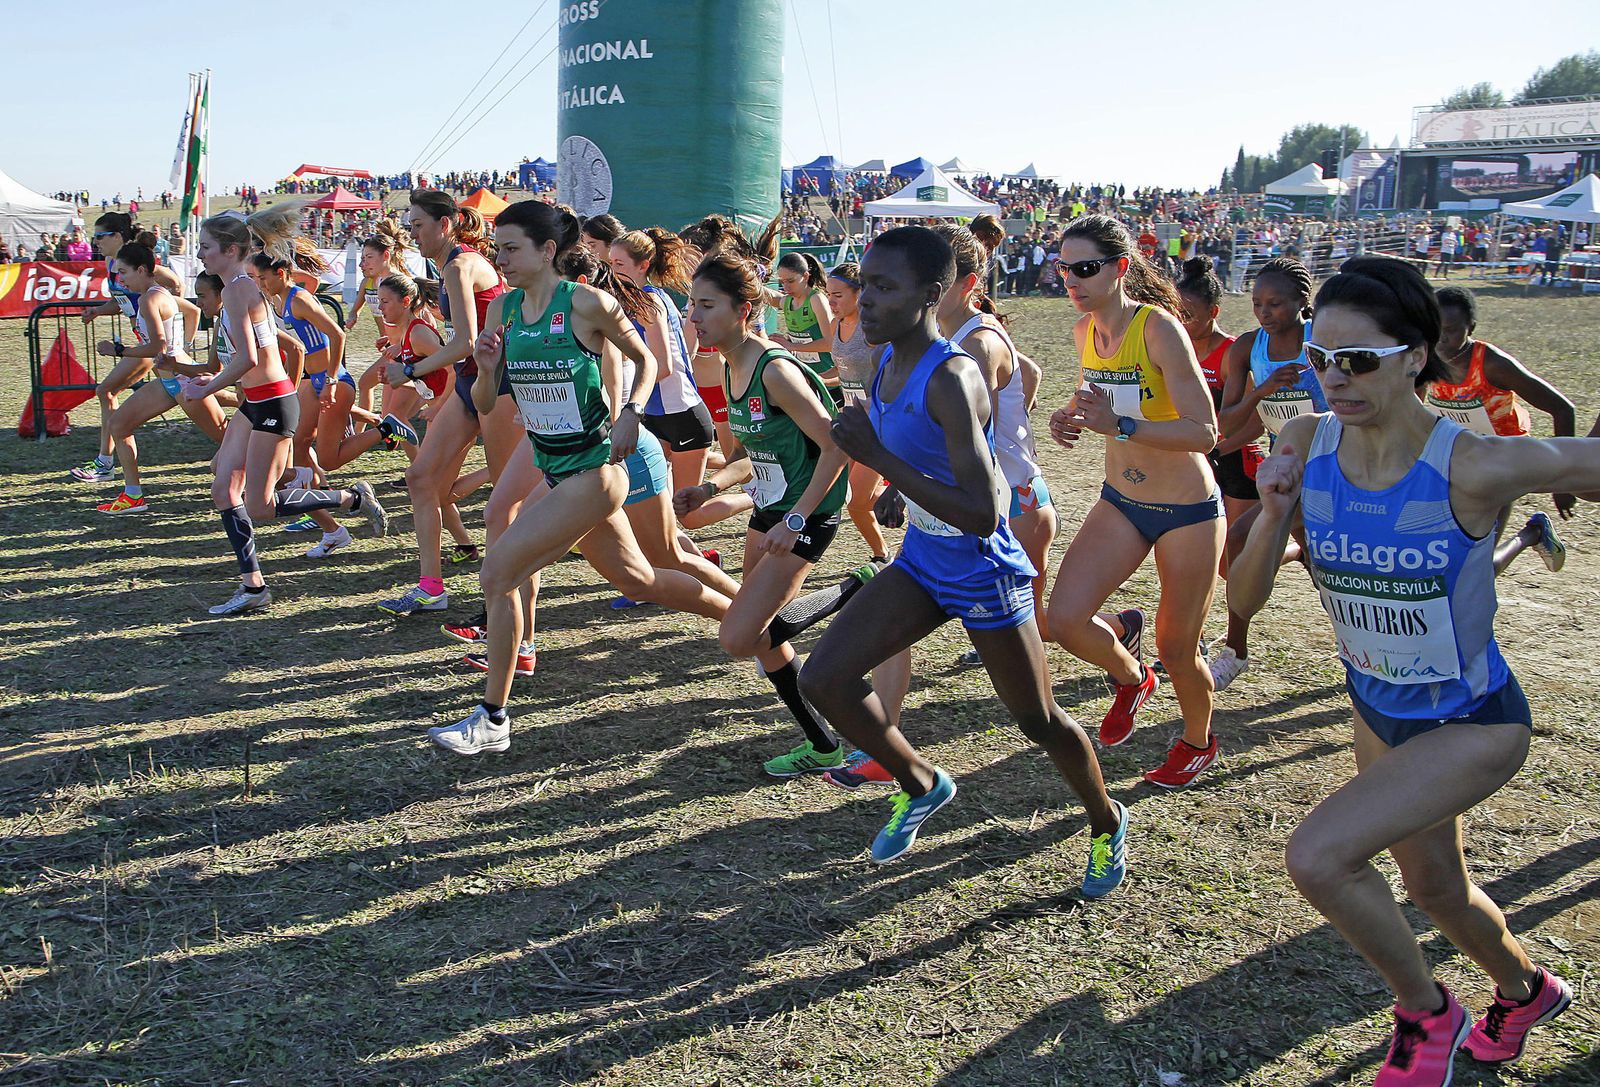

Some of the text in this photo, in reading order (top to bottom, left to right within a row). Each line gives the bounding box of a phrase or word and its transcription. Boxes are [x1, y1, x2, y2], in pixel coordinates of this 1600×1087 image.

[560, 85, 625, 110] ITÁLICA
[1103, 372, 1114, 380] DE
[1114, 370, 1137, 381] SEVILLA
[1374, 581, 1390, 593] DE
[1393, 581, 1441, 595] SEVILLA
[1328, 596, 1428, 637] LUGUEROS
